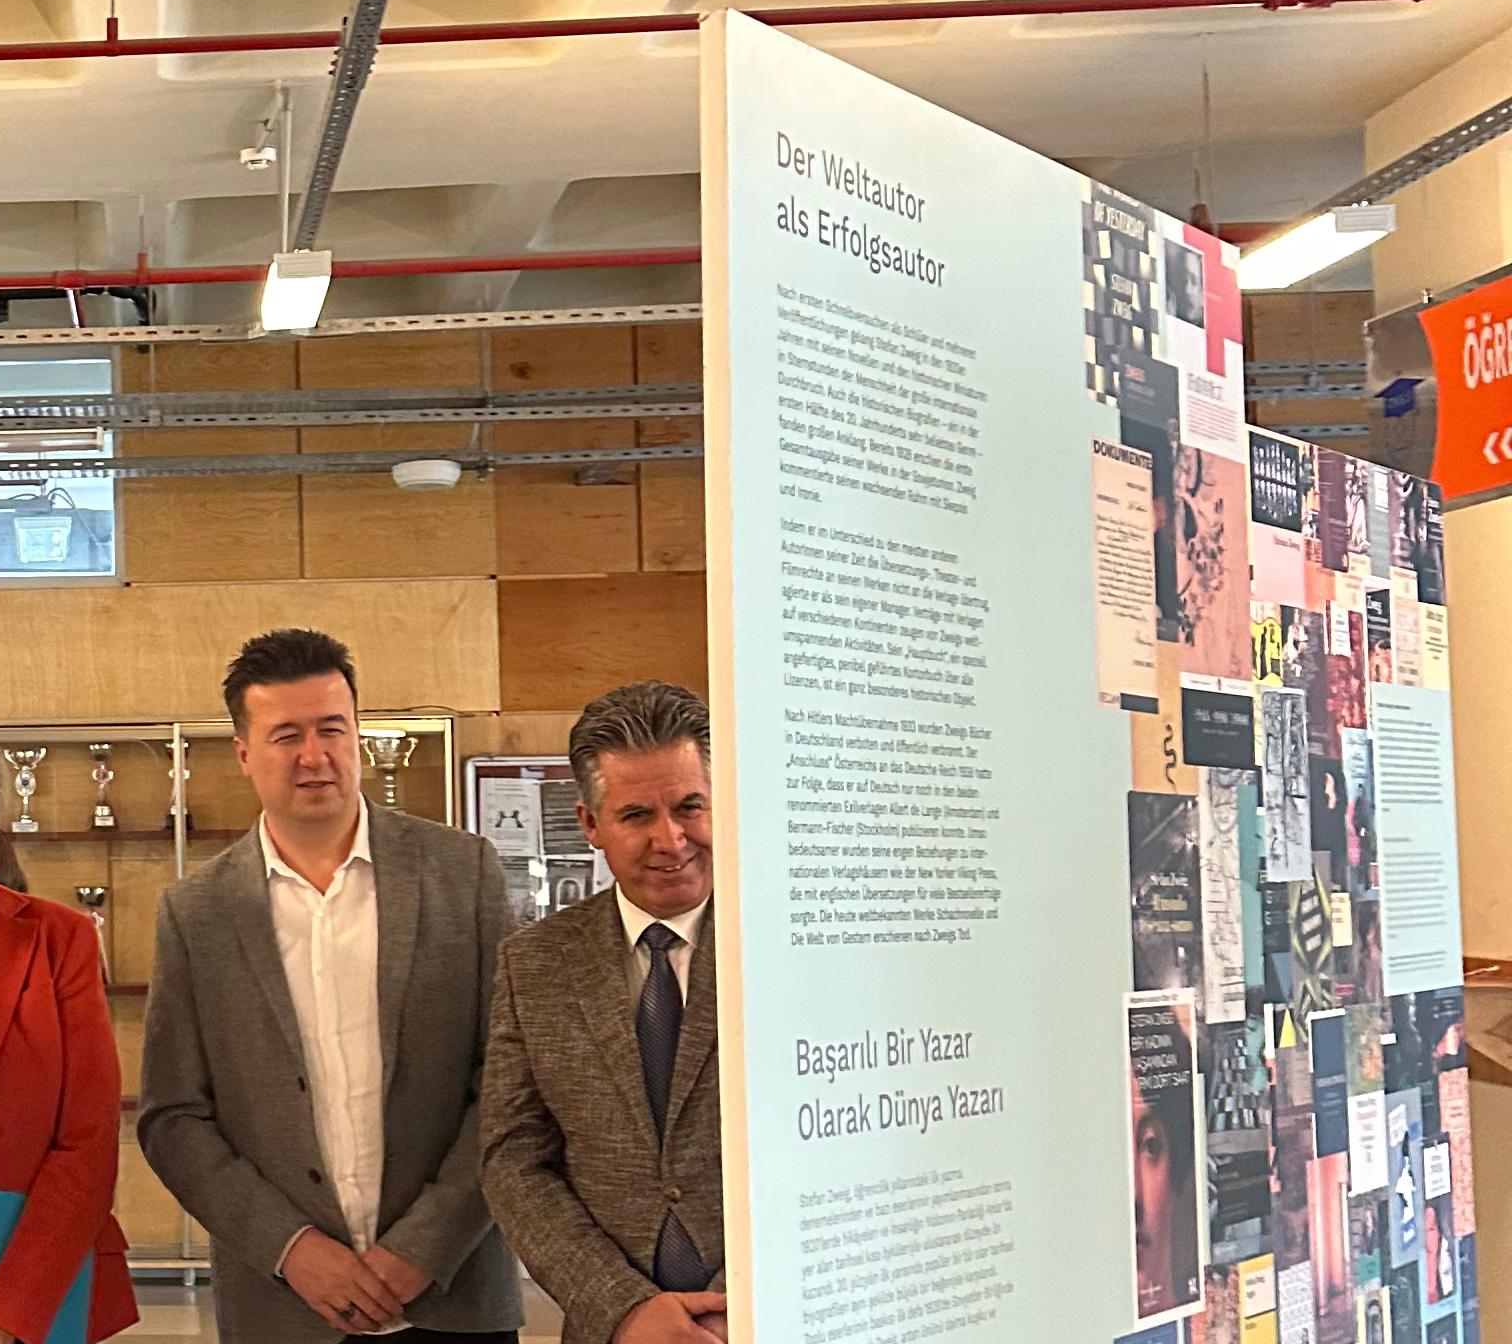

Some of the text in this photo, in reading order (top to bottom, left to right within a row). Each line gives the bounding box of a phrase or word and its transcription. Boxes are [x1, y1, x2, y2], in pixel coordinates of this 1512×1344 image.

[777, 131, 925, 223] Der Weltautor
[777, 195, 945, 287] als Erfolgsautor
[786, 778, 798, 788] zur
[801, 776, 824, 793] Folge,
[827, 778, 843, 791] dass
[846, 782, 853, 792] er
[856, 779, 867, 792] auf
[790, 887, 802, 900] die
[820, 910, 831, 922] Die
[791, 932, 804, 945] Die
[807, 930, 824, 944] Welt
[796, 1028, 972, 1084] Başarılı Bir Yazar
[798, 1084, 1003, 1141] Olarak Dünya Yazarı
